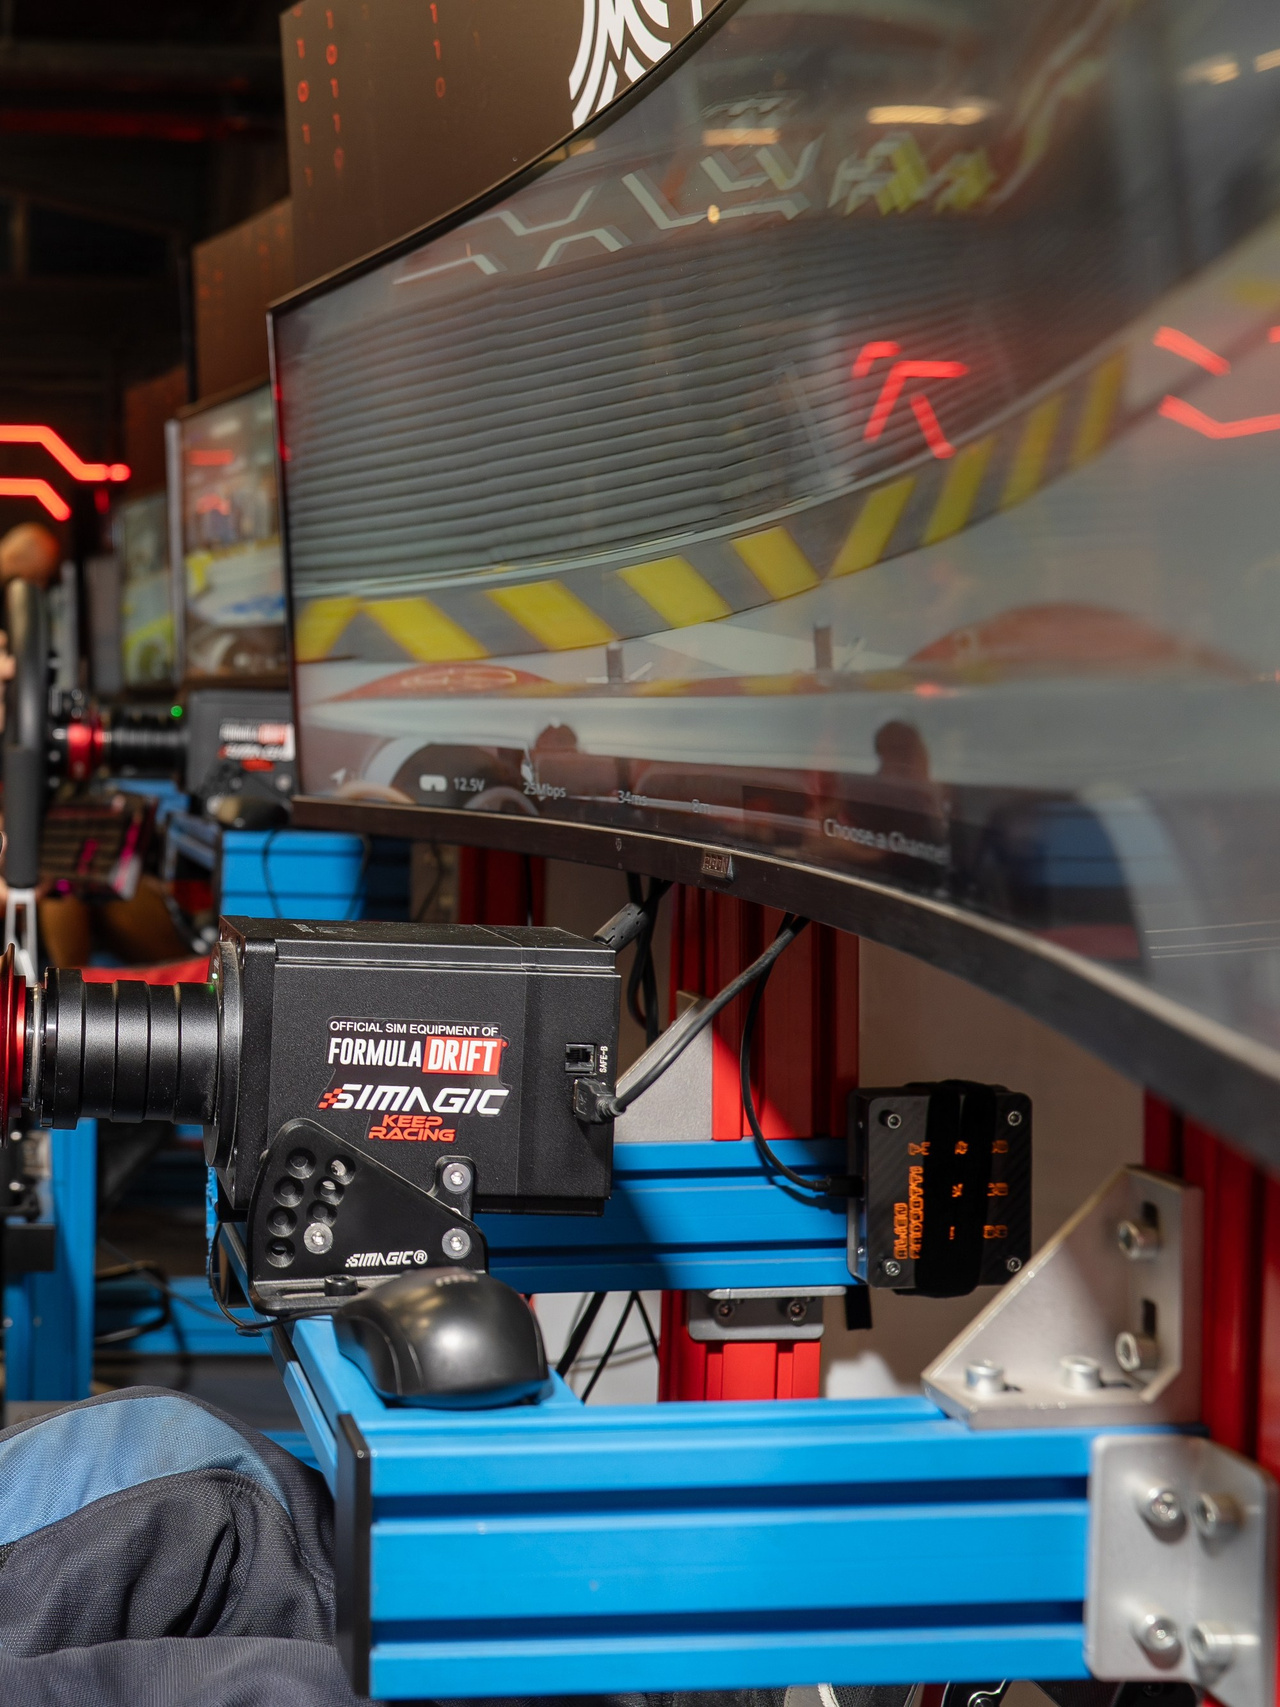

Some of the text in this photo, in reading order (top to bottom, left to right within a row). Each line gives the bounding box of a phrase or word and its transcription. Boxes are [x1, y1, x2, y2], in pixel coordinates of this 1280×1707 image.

[329, 1021, 499, 1037] OFFICIAL SIM EQUIPMENT OF
[327, 1037, 498, 1073] FORMULA DRIFT
[599, 1045, 609, 1074] SAFE-B
[328, 1083, 510, 1115] SIMAGIC
[381, 1114, 443, 1129] KEEP
[368, 1126, 456, 1142] RACING
